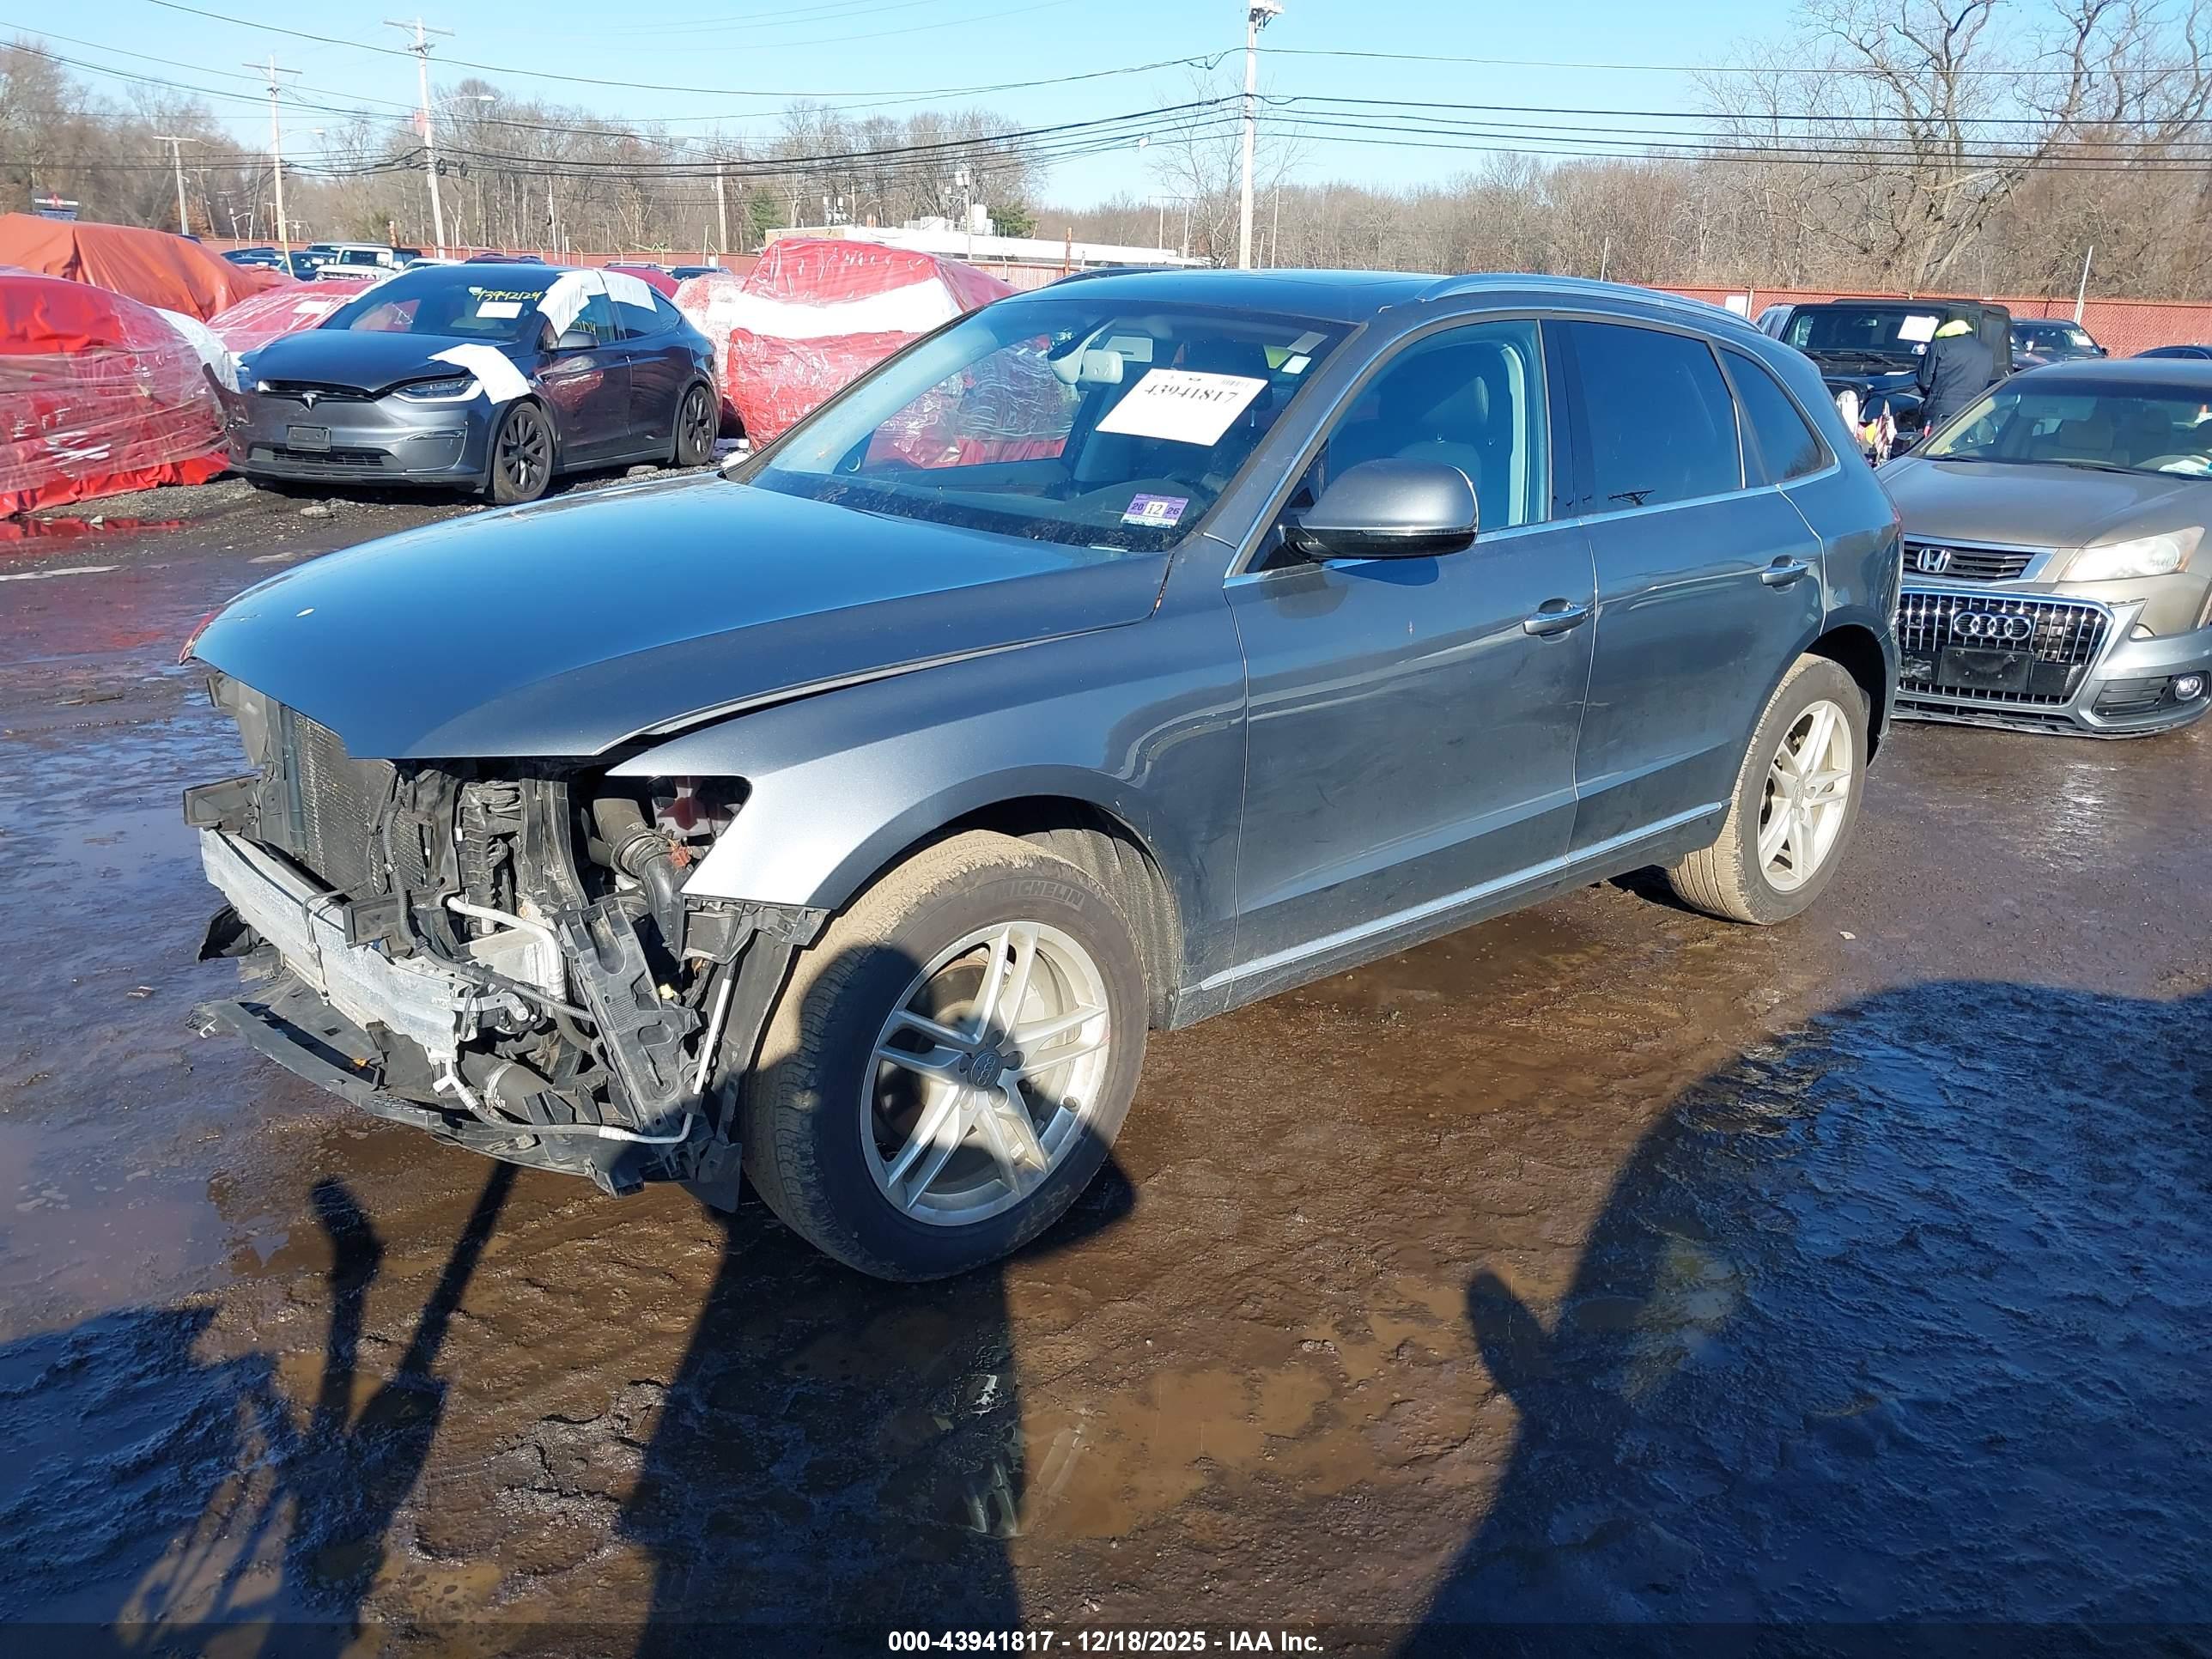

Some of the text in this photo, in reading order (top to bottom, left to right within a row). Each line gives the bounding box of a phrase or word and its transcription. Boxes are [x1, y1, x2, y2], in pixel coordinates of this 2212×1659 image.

[1144, 384, 1238, 404] 43941817
[1131, 502, 1181, 515] 20 12 26
[994, 880, 1085, 908] MICHELIN
